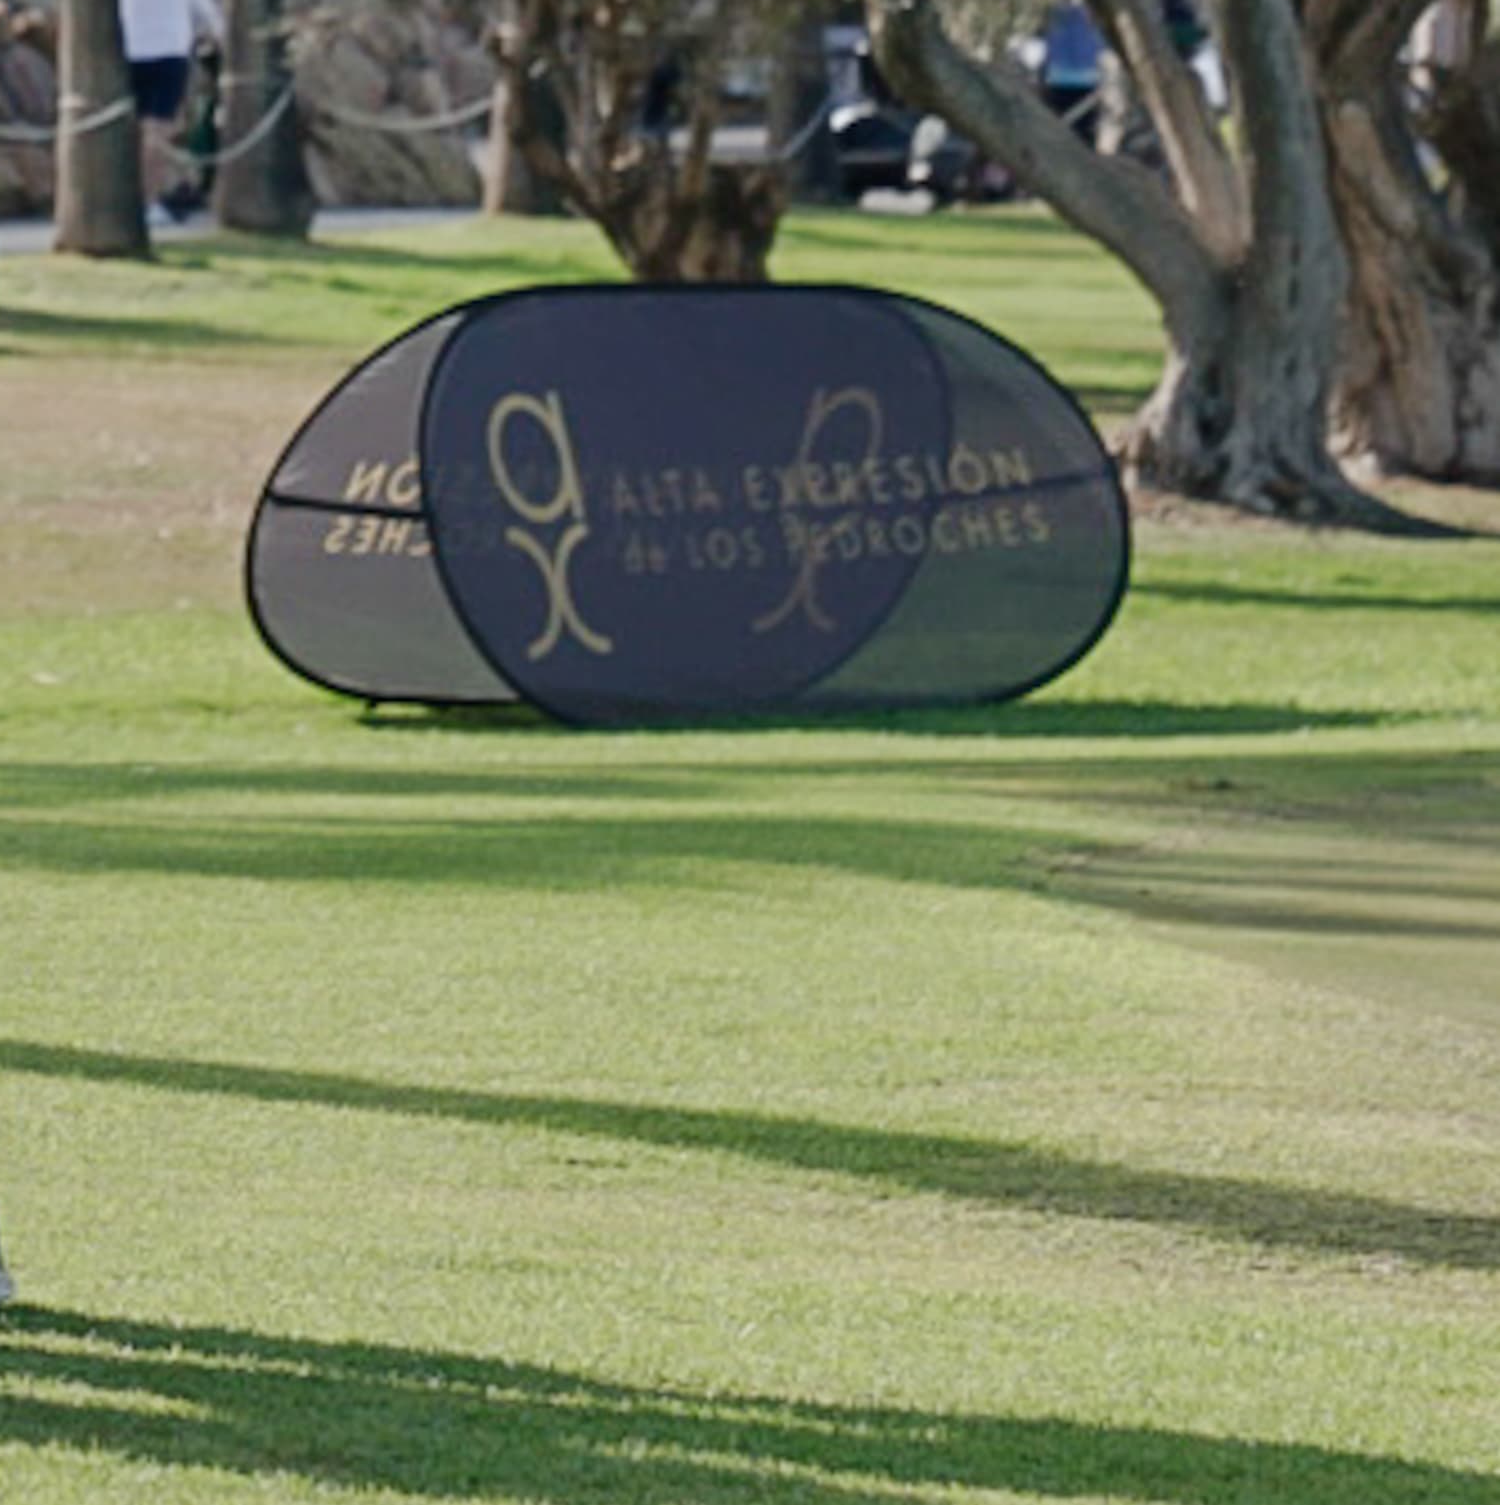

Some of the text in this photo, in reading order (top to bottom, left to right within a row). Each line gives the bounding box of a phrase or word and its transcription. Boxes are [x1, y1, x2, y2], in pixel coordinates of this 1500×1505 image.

[613, 441, 1033, 517] ALTA EXPRESIÓN
[624, 499, 1051, 574] de LOS PEDROCHES
